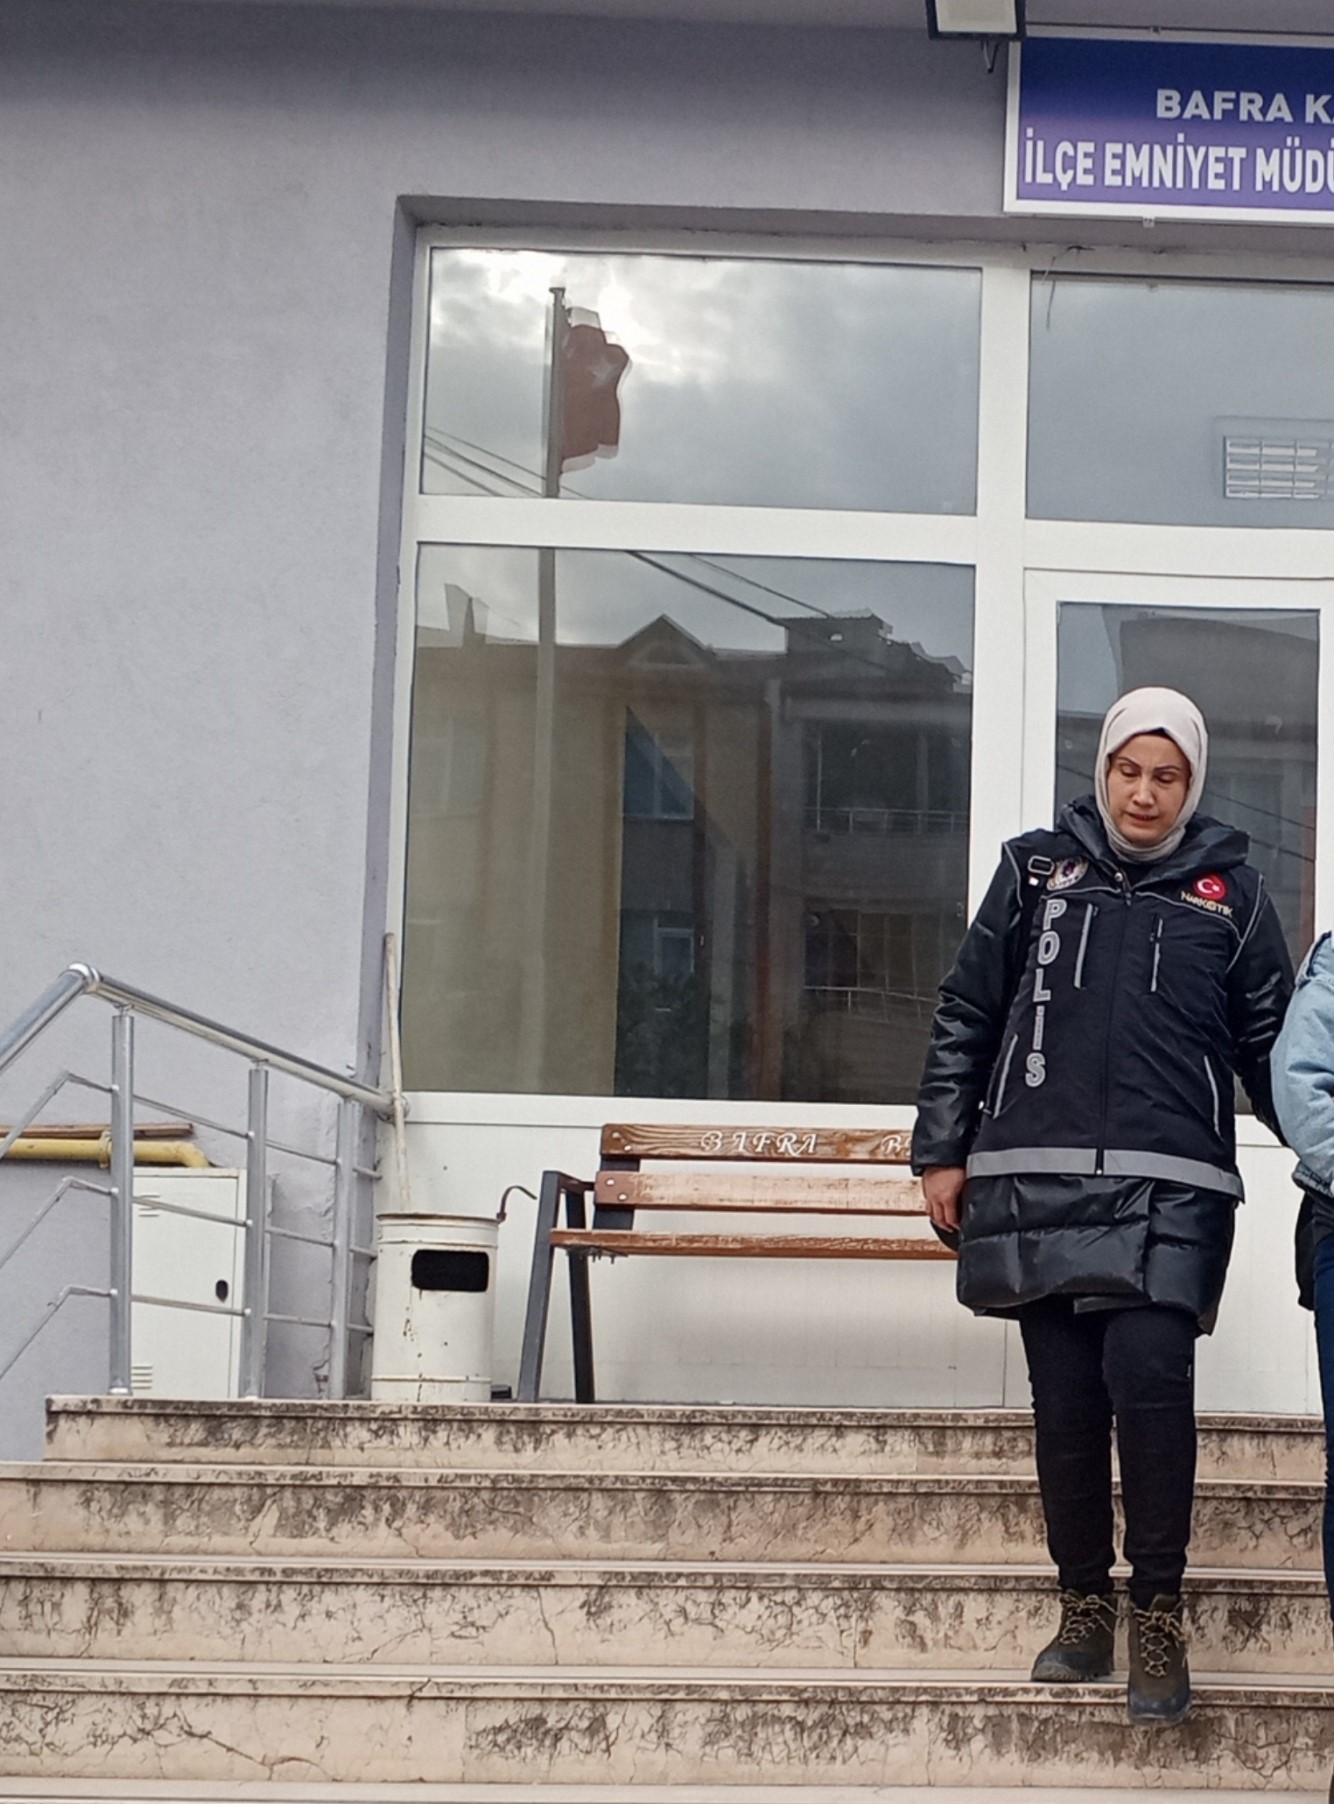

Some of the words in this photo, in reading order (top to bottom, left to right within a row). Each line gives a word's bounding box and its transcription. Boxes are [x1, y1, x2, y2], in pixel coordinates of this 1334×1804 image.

[1156, 88, 1294, 123] BAFRA
[1024, 127, 1095, 191] İLÇE
[1104, 132, 1247, 191] EMNİYET
[1024, 898, 1066, 1088] POLİS
[700, 1130, 816, 1157] BAFRA
